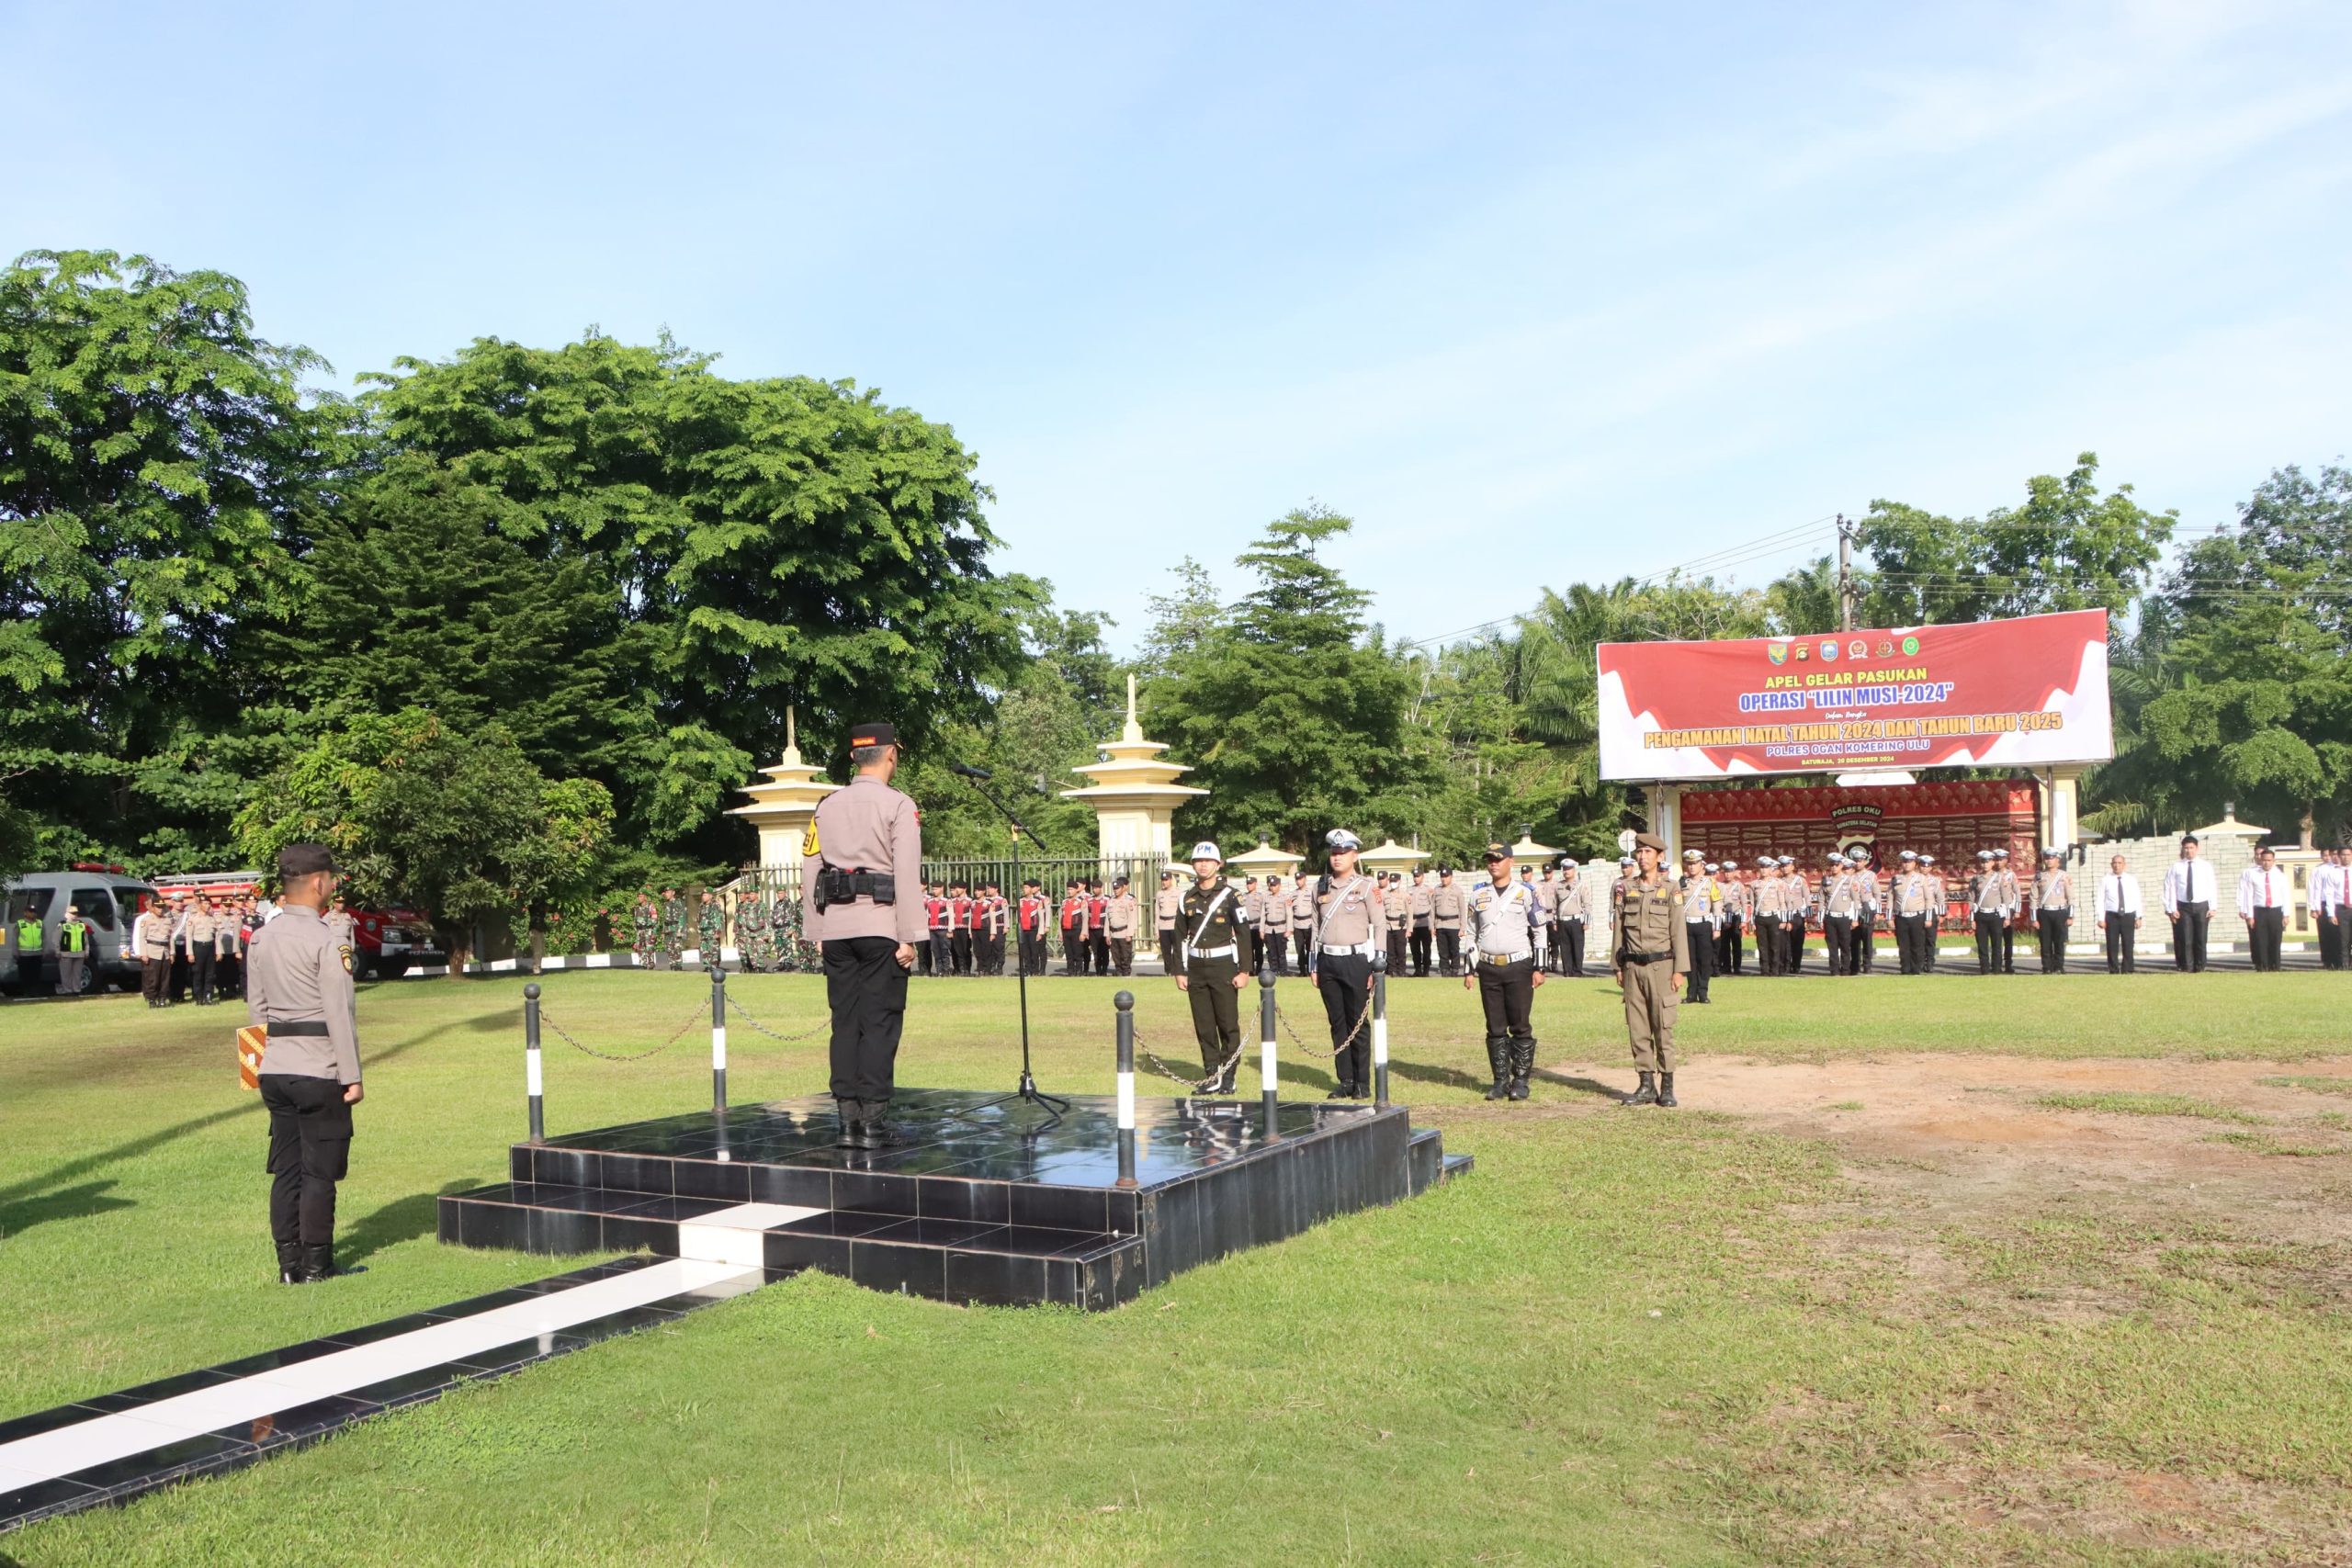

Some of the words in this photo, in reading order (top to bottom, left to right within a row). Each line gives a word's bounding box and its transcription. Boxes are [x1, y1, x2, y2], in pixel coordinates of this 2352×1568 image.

[1765, 676, 1803, 689] APEL
[1805, 672, 1853, 686] GELAR
[1857, 668, 1928, 683] PASUKAN
[1740, 692, 1805, 711] OPERASI
[1644, 728, 1743, 749] PENGAMANAN
[1745, 726, 1789, 744] NATAL
[1791, 724, 1839, 741] TAHUN
[1842, 721, 1883, 739] 2024
[1884, 719, 1917, 738] DAN
[1918, 716, 1971, 736] TAHUN
[1973, 714, 2017, 734] BARU
[2019, 712, 2064, 731] 2025
[1767, 746, 1809, 756] POLRES
[1812, 744, 1843, 754] OGAN
[1846, 741, 1905, 752] KOMERING
[1906, 740, 1930, 750] ULU
[1832, 806, 1862, 818] POLRES
[1863, 807, 1882, 816] OKU
[1859, 819, 1878, 828] SELATAN
[1197, 844, 1212, 853] PM
